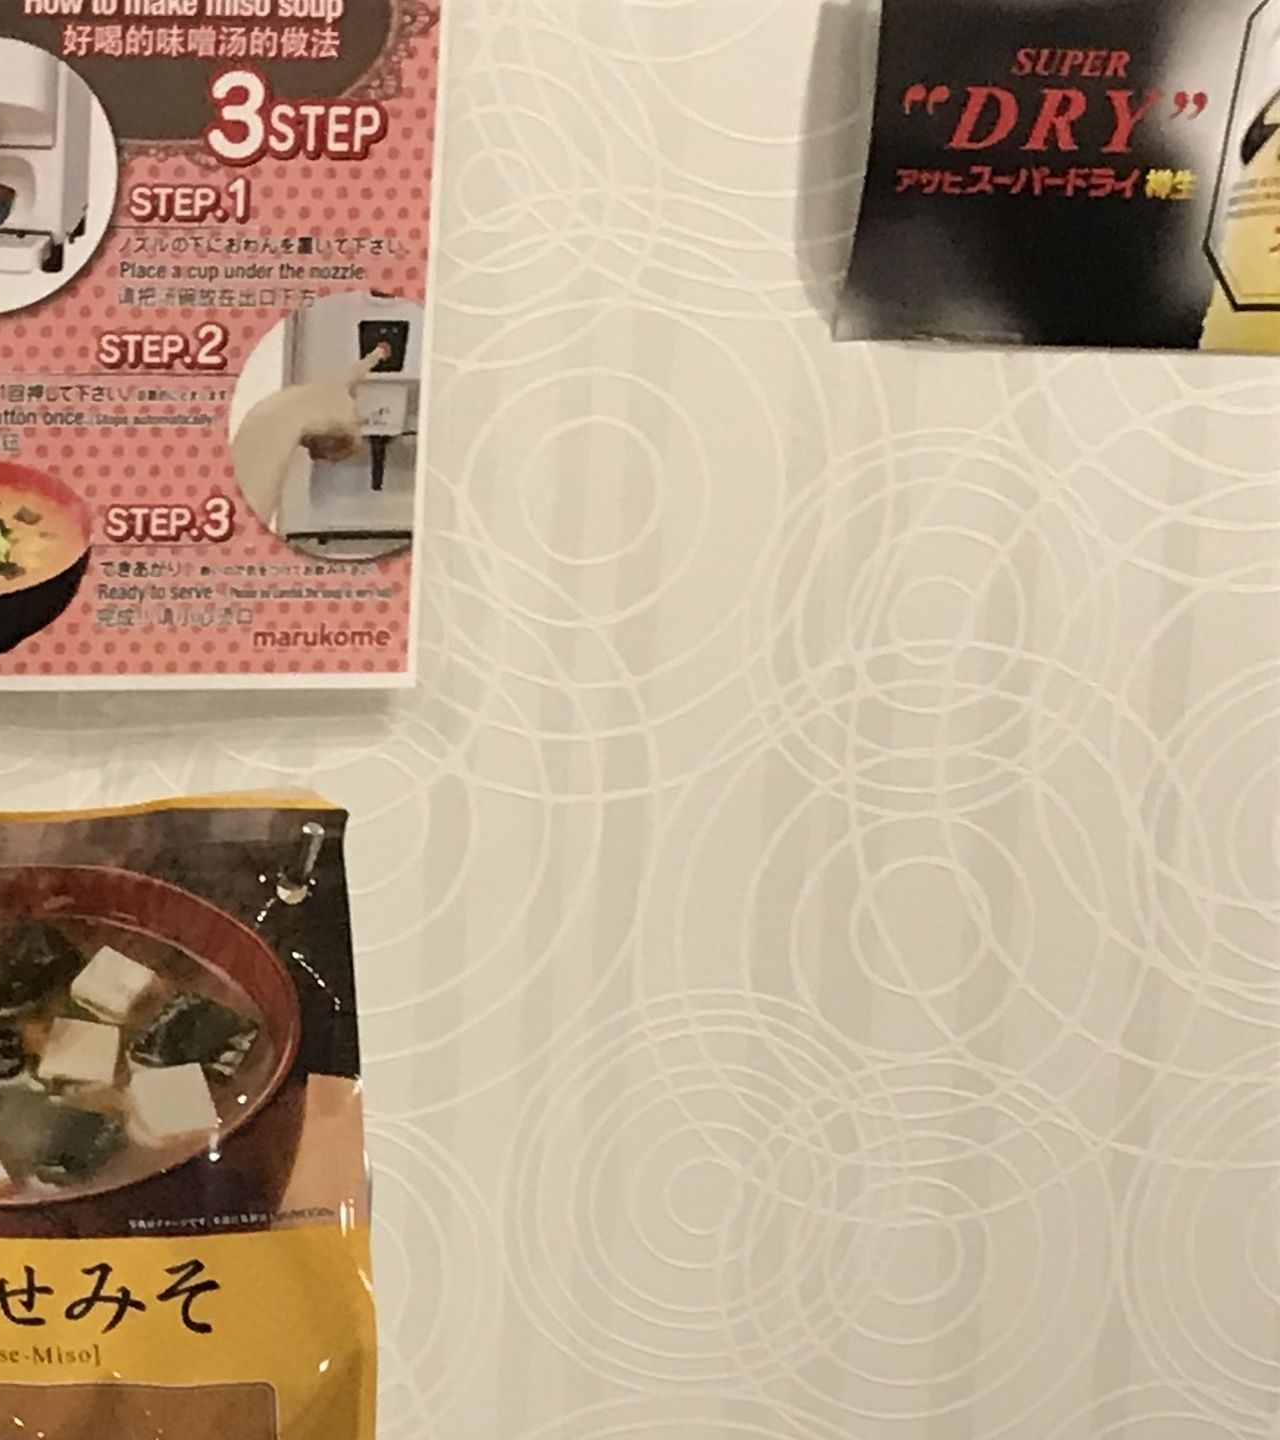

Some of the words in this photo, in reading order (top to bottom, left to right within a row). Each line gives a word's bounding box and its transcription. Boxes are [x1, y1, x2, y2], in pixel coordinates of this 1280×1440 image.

[1011, 48, 1131, 77] SUPER
[894, 165, 1140, 198] アサヒスーパードライ
[130, 178, 248, 220] STEP.1
[120, 261, 165, 279] Place
[171, 264, 182, 279] a
[188, 265, 218, 282] cup
[224, 263, 273, 279] under
[279, 263, 305, 279] the
[100, 324, 224, 366] STEP.2
[106, 498, 231, 538] STEP.3
[98, 583, 144, 603] Ready
[150, 585, 166, 599] to
[170, 586, 213, 599] serve
[252, 623, 391, 647] marukome
